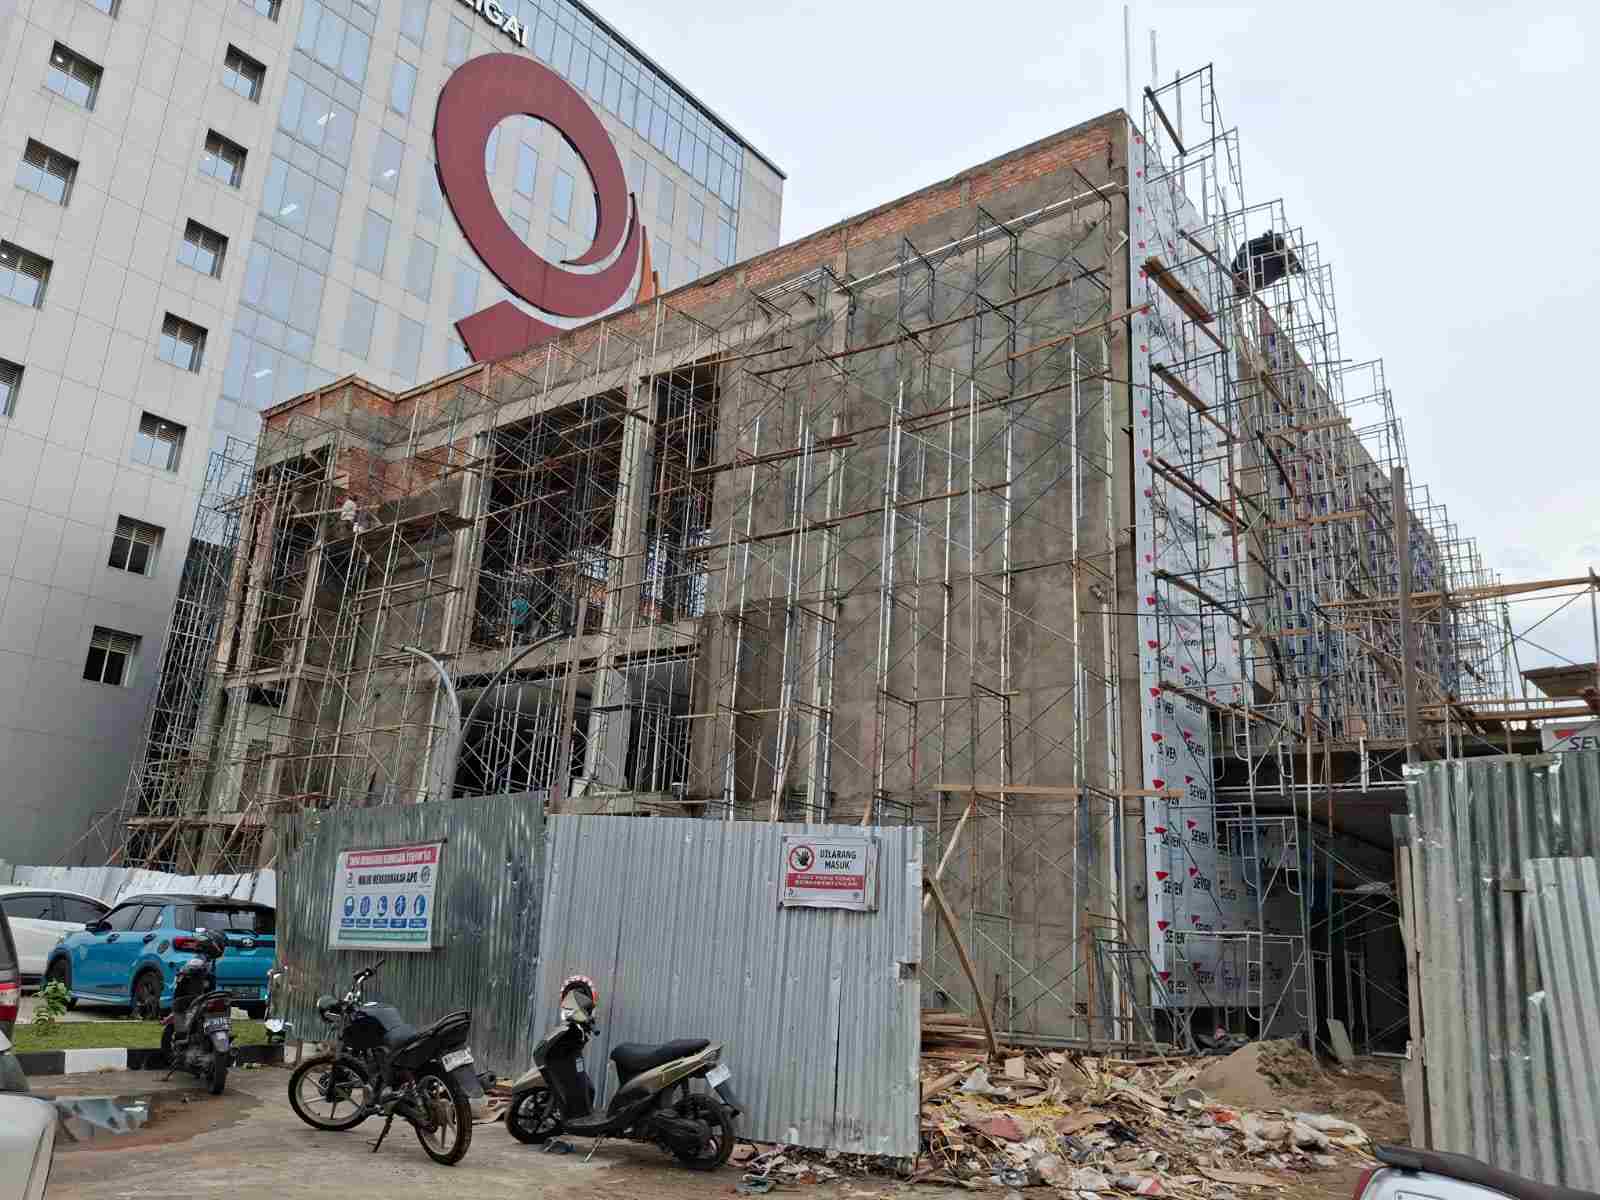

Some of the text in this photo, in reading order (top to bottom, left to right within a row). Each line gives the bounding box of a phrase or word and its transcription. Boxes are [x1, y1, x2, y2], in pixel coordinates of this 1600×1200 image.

[458, 0, 529, 47] IGAI
[819, 848, 857, 860] DILARANG
[824, 860, 851, 870] MASUK
